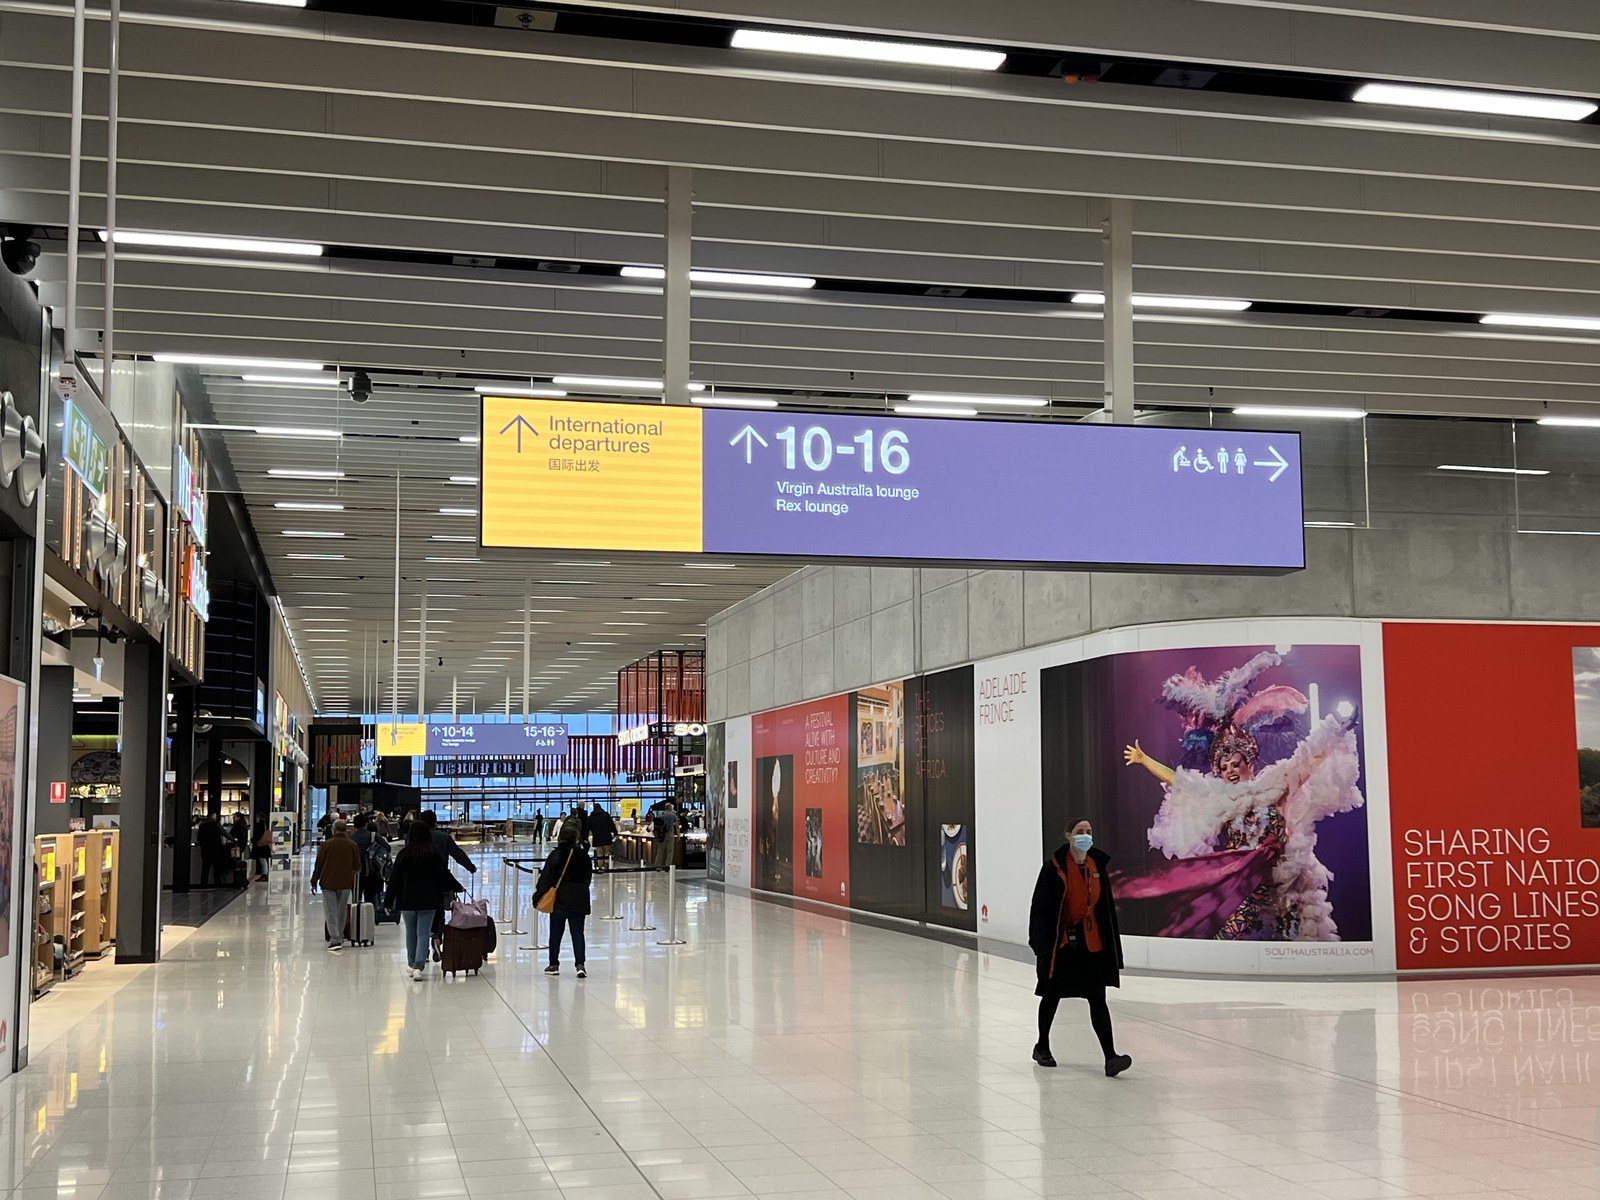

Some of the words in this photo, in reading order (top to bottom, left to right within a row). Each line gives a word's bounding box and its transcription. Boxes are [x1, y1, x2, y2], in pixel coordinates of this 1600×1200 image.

[549, 415, 663, 436] International
[549, 434, 650, 454] departures
[775, 426, 911, 475] 10-16
[548, 458, 600, 472] 国际出发
[776, 481, 814, 497] Virgin
[816, 483, 873, 498] Australia
[876, 485, 920, 501] lounge
[776, 499, 802, 512] Rex
[805, 500, 849, 516] lounge
[979, 671, 1027, 701] ADELAIDE
[805, 714, 810, 730] A
[810, 711, 834, 729] FESTIVAL
[979, 700, 1014, 726] FRINGE
[441, 726, 475, 738] 10-14
[523, 726, 556, 738] 15-16
[805, 730, 820, 748] ALIVE
[820, 729, 836, 746] WITH
[805, 748, 828, 766] CULTURE
[828, 747, 841, 764] AND
[805, 767, 839, 785] CREATIVITY?
[915, 758, 947, 780] AFRICA
[1404, 827, 1550, 856] SHARING
[1406, 860, 1494, 889] FIRST
[1505, 858, 1600, 887] NATIO
[1407, 892, 1502, 922] SONG
[1512, 890, 1600, 918] LINES
[1409, 926, 1429, 954] &
[1440, 922, 1572, 954] STORIES
[1264, 947, 1375, 957] SOUTHAUSTRALIA.COM
